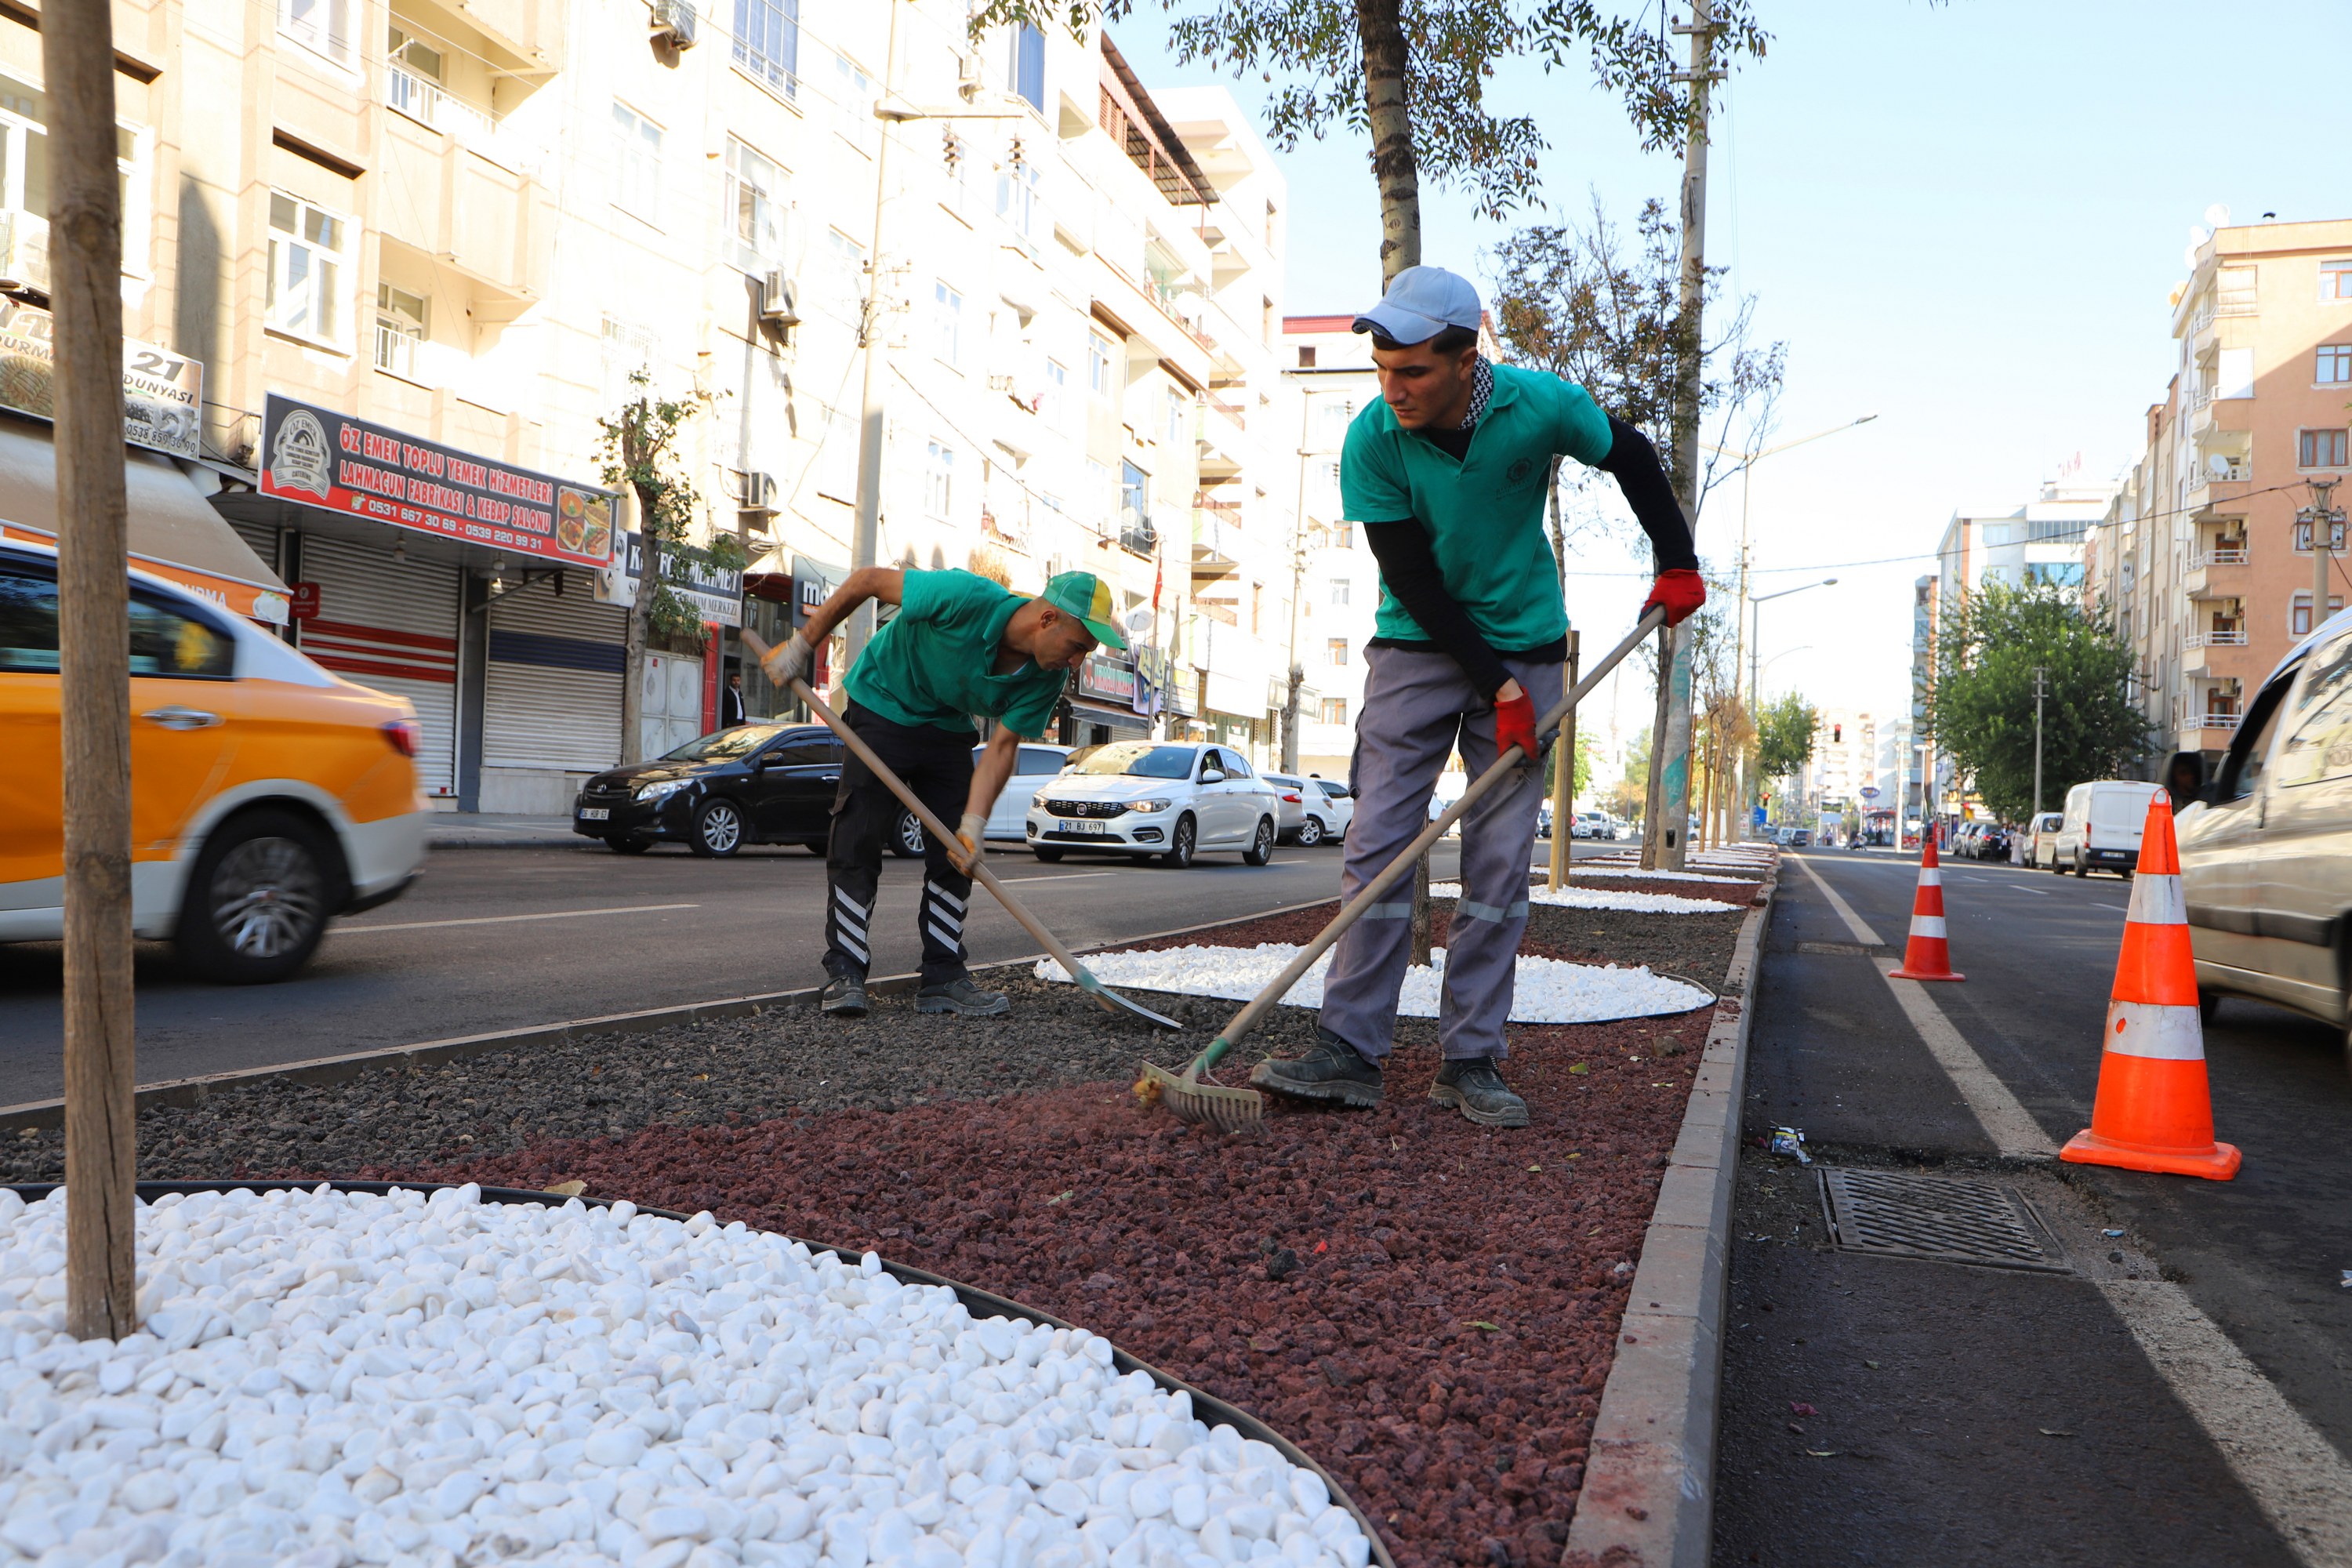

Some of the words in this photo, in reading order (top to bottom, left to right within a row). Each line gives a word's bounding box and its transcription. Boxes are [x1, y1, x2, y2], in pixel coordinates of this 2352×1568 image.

[0, 333, 54, 361] URM
[130, 351, 184, 382] 21
[126, 424, 149, 439] 0538
[340, 423, 361, 453] ÖZ
[364, 431, 401, 466] EMEK
[403, 443, 445, 477] TOPLU
[447, 456, 487, 490] YEMEK
[339, 459, 405, 500] LAHMACUN
[466, 494, 475, 517] &
[477, 496, 510, 525] KEBAP
[511, 504, 551, 534] SALONU
[368, 499, 397, 517] 0531
[401, 507, 423, 523] 667
[425, 514, 439, 528] 30
[442, 518, 456, 532] 69
[466, 524, 492, 539] 0539
[494, 530, 513, 543] 220
[516, 535, 528, 546] 99
[530, 539, 542, 550] 31
